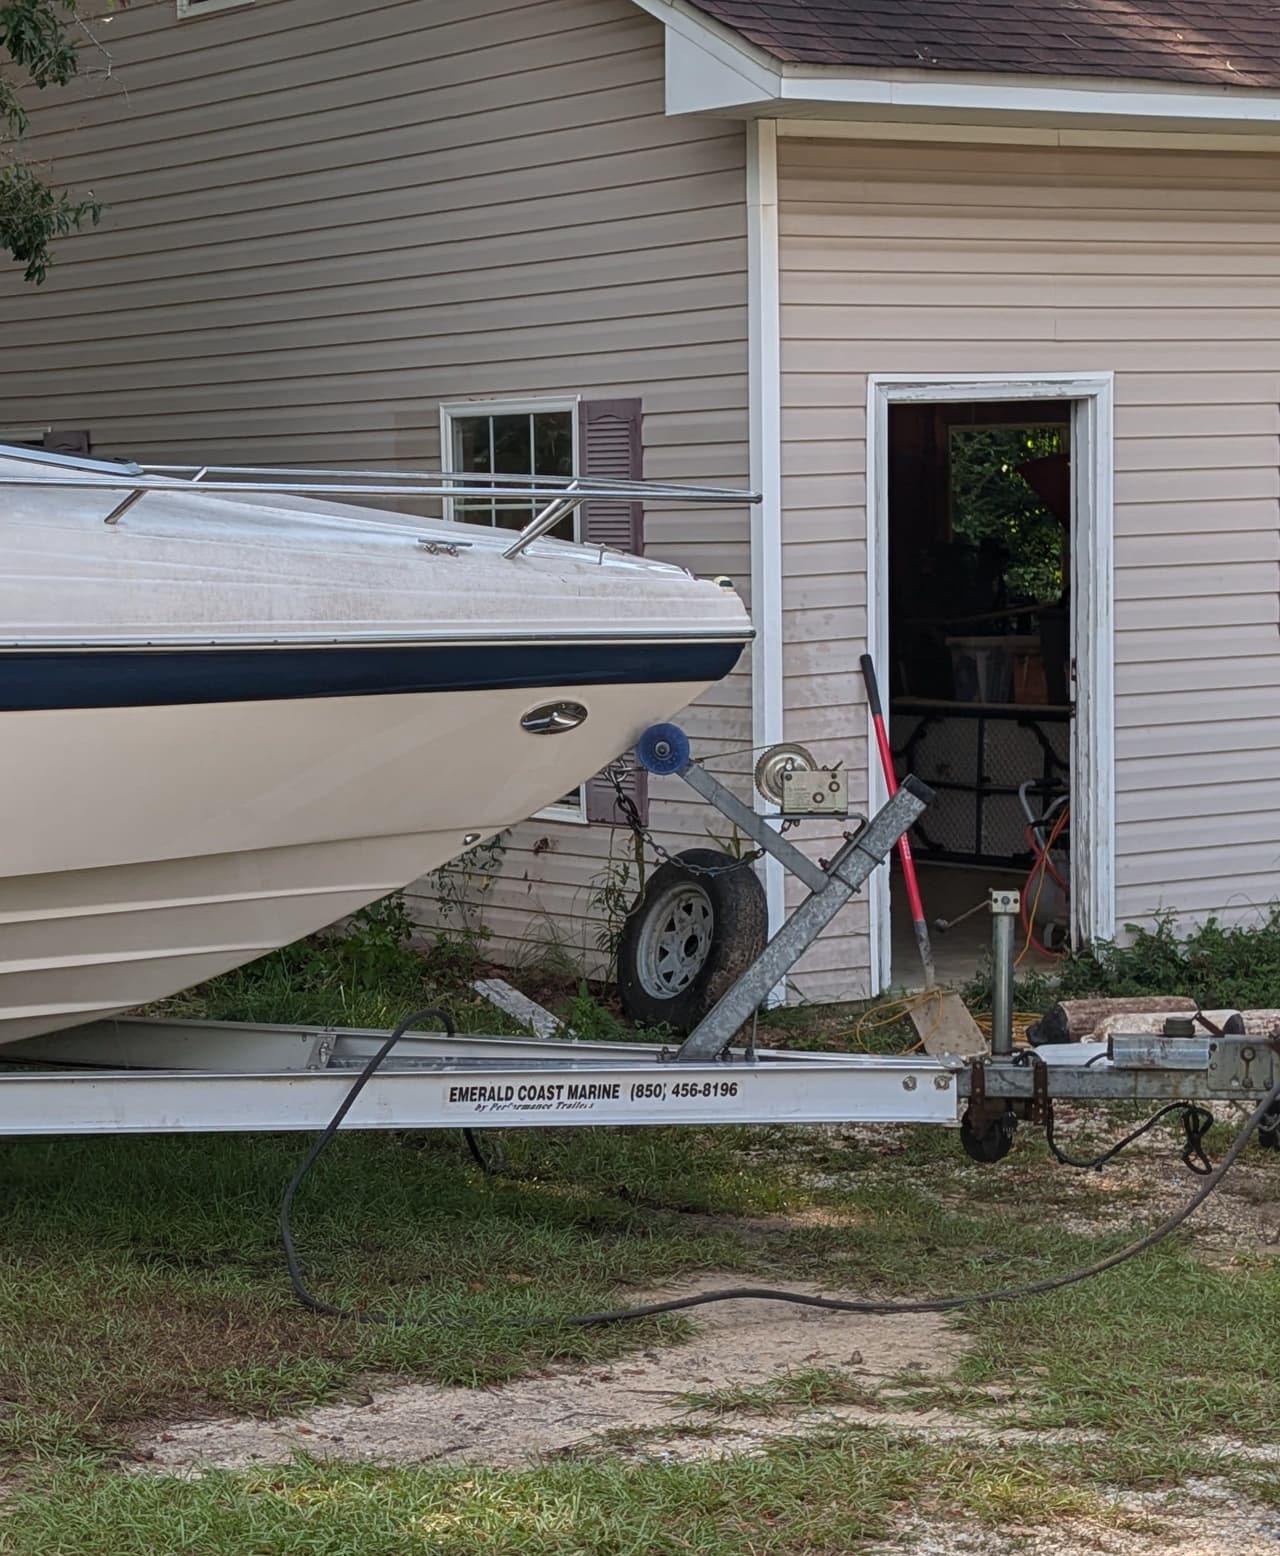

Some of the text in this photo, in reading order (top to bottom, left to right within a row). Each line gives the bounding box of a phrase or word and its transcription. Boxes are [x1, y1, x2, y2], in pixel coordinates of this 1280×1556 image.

[449, 1082, 738, 1102] EMERALD COAST MARINE (850) 456-8196
[474, 1104, 488, 1112] by
